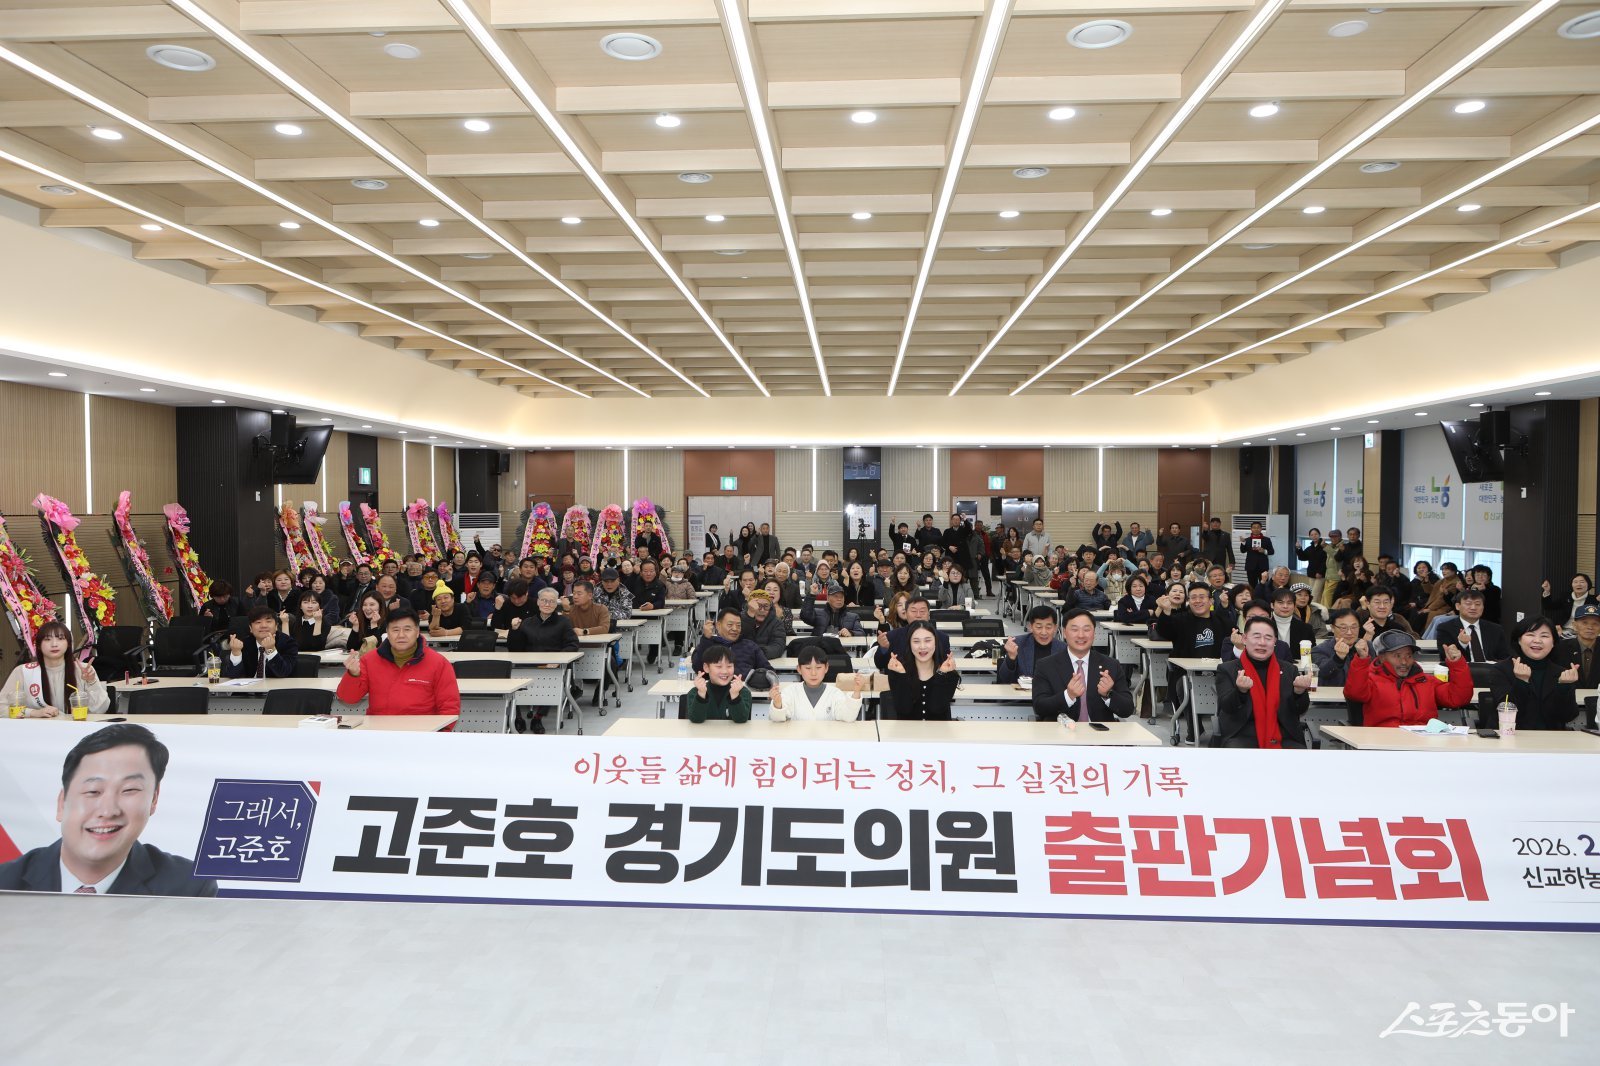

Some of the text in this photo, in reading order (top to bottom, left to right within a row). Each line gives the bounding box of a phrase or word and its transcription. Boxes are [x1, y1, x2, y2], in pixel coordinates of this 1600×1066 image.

[574, 752, 1189, 798] 이웃들 삶에 힘이되는 정치, 그 실천의 기록
[216, 797, 302, 830] 그래서,
[207, 835, 291, 863] 고준호
[332, 795, 1489, 901] 고준호 경기도의원 출판기념회
